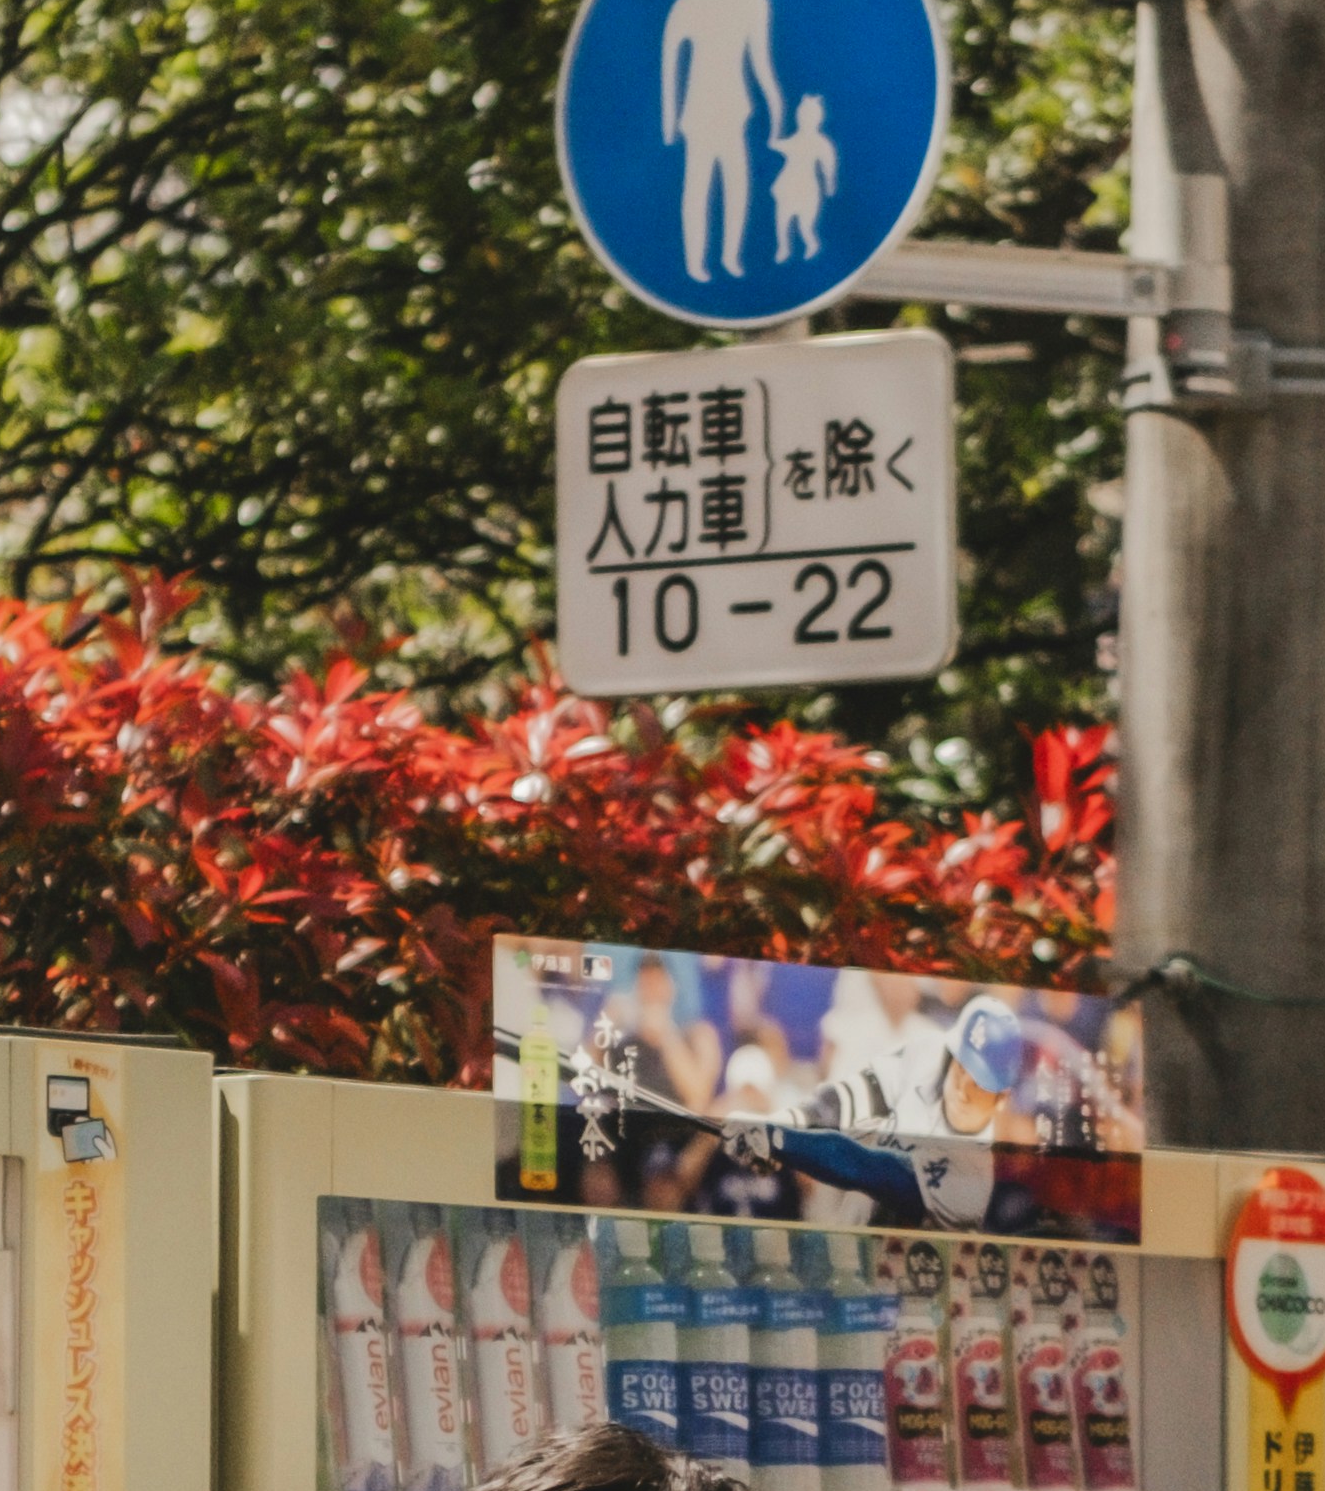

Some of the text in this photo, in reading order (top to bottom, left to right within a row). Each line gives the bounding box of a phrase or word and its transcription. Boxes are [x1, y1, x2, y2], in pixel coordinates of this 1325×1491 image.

[589, 385, 746, 475] 自転車
[784, 416, 915, 501] を除く
[587, 472, 748, 563] 人力車
[570, 1044, 616, 1162] お茶
[366, 1339, 389, 1432] evian
[430, 1343, 455, 1434] evian
[505, 1346, 529, 1438] evian
[577, 1352, 601, 1425] vian
